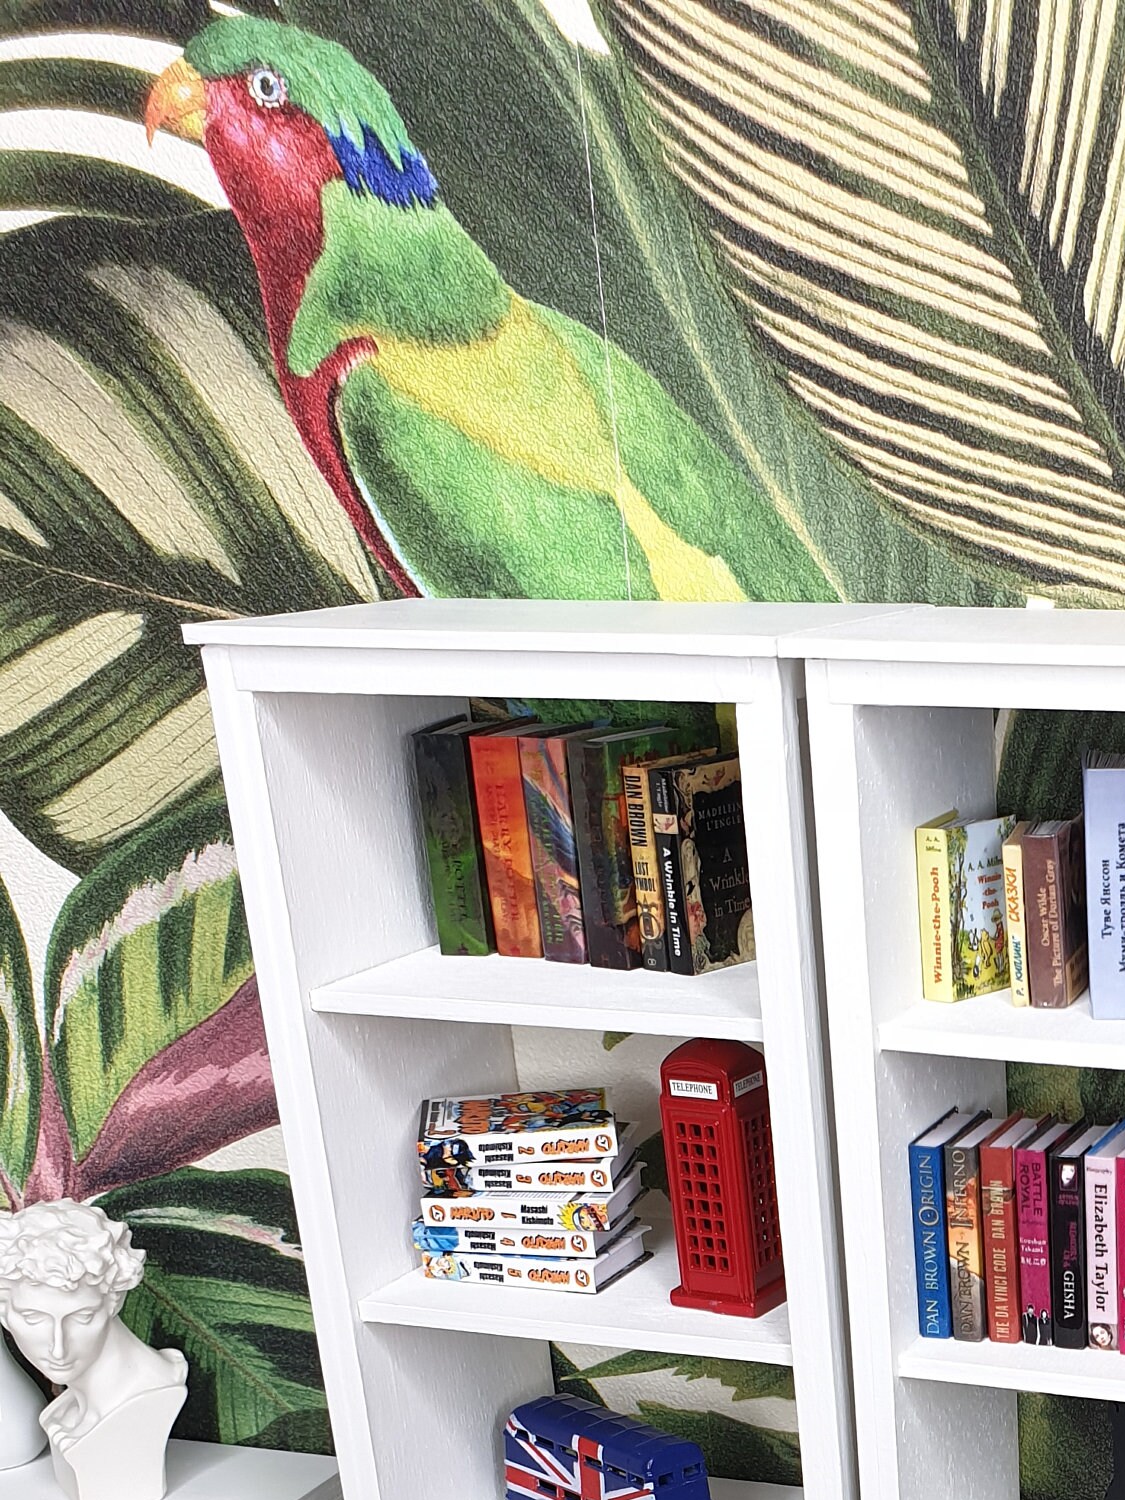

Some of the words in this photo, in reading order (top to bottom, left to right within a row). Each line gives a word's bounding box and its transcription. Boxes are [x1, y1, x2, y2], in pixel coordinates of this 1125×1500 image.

[625, 776, 643, 799] DAN
[495, 784, 512, 849] HARRY
[628, 804, 648, 847] BROWN
[1005, 867, 1020, 922] СКАЗКИ
[1100, 859, 1111, 906] Янссон
[714, 903, 723, 918] in
[725, 895, 751, 914] Time
[1037, 887, 1047, 917] Wilde
[929, 866, 943, 984] Winnie-the-Pooh
[1041, 919, 1050, 947] Oscar
[1101, 907, 1113, 940] Туве
[671, 1081, 713, 1096] TELEPHONE
[734, 1075, 761, 1093] TELEPHONE
[478, 1142, 513, 1153] Kishimoto
[541, 1138, 590, 1155] NARUTO
[538, 1170, 585, 1185] NARUTO
[918, 1154, 940, 1227] ORIGIN
[950, 1149, 974, 1230] INFERNO
[1020, 1164, 1030, 1213] ROYAL
[1032, 1163, 1042, 1217] BATTLE
[520, 1204, 548, 1214] Masashi
[990, 1179, 1004, 1215] BROWN
[450, 1206, 495, 1223] NARUTO
[521, 1215, 554, 1226] Kishimoto
[991, 1219, 1006, 1239] DAN
[1093, 1184, 1108, 1258] Elizabeth
[921, 1231, 939, 1291] BROWN
[956, 1241, 973, 1299] BROWN
[993, 1247, 1006, 1273] CODE
[528, 1267, 571, 1285] NARUTO
[994, 1275, 1008, 1303] VINCI
[1092, 1262, 1109, 1313] Taylor
[1063, 1270, 1076, 1320] GEISHA
[926, 1299, 940, 1335] DAN
[960, 1301, 973, 1335] DAN
[995, 1305, 1009, 1318] DA
[996, 1321, 1010, 1339] THE
